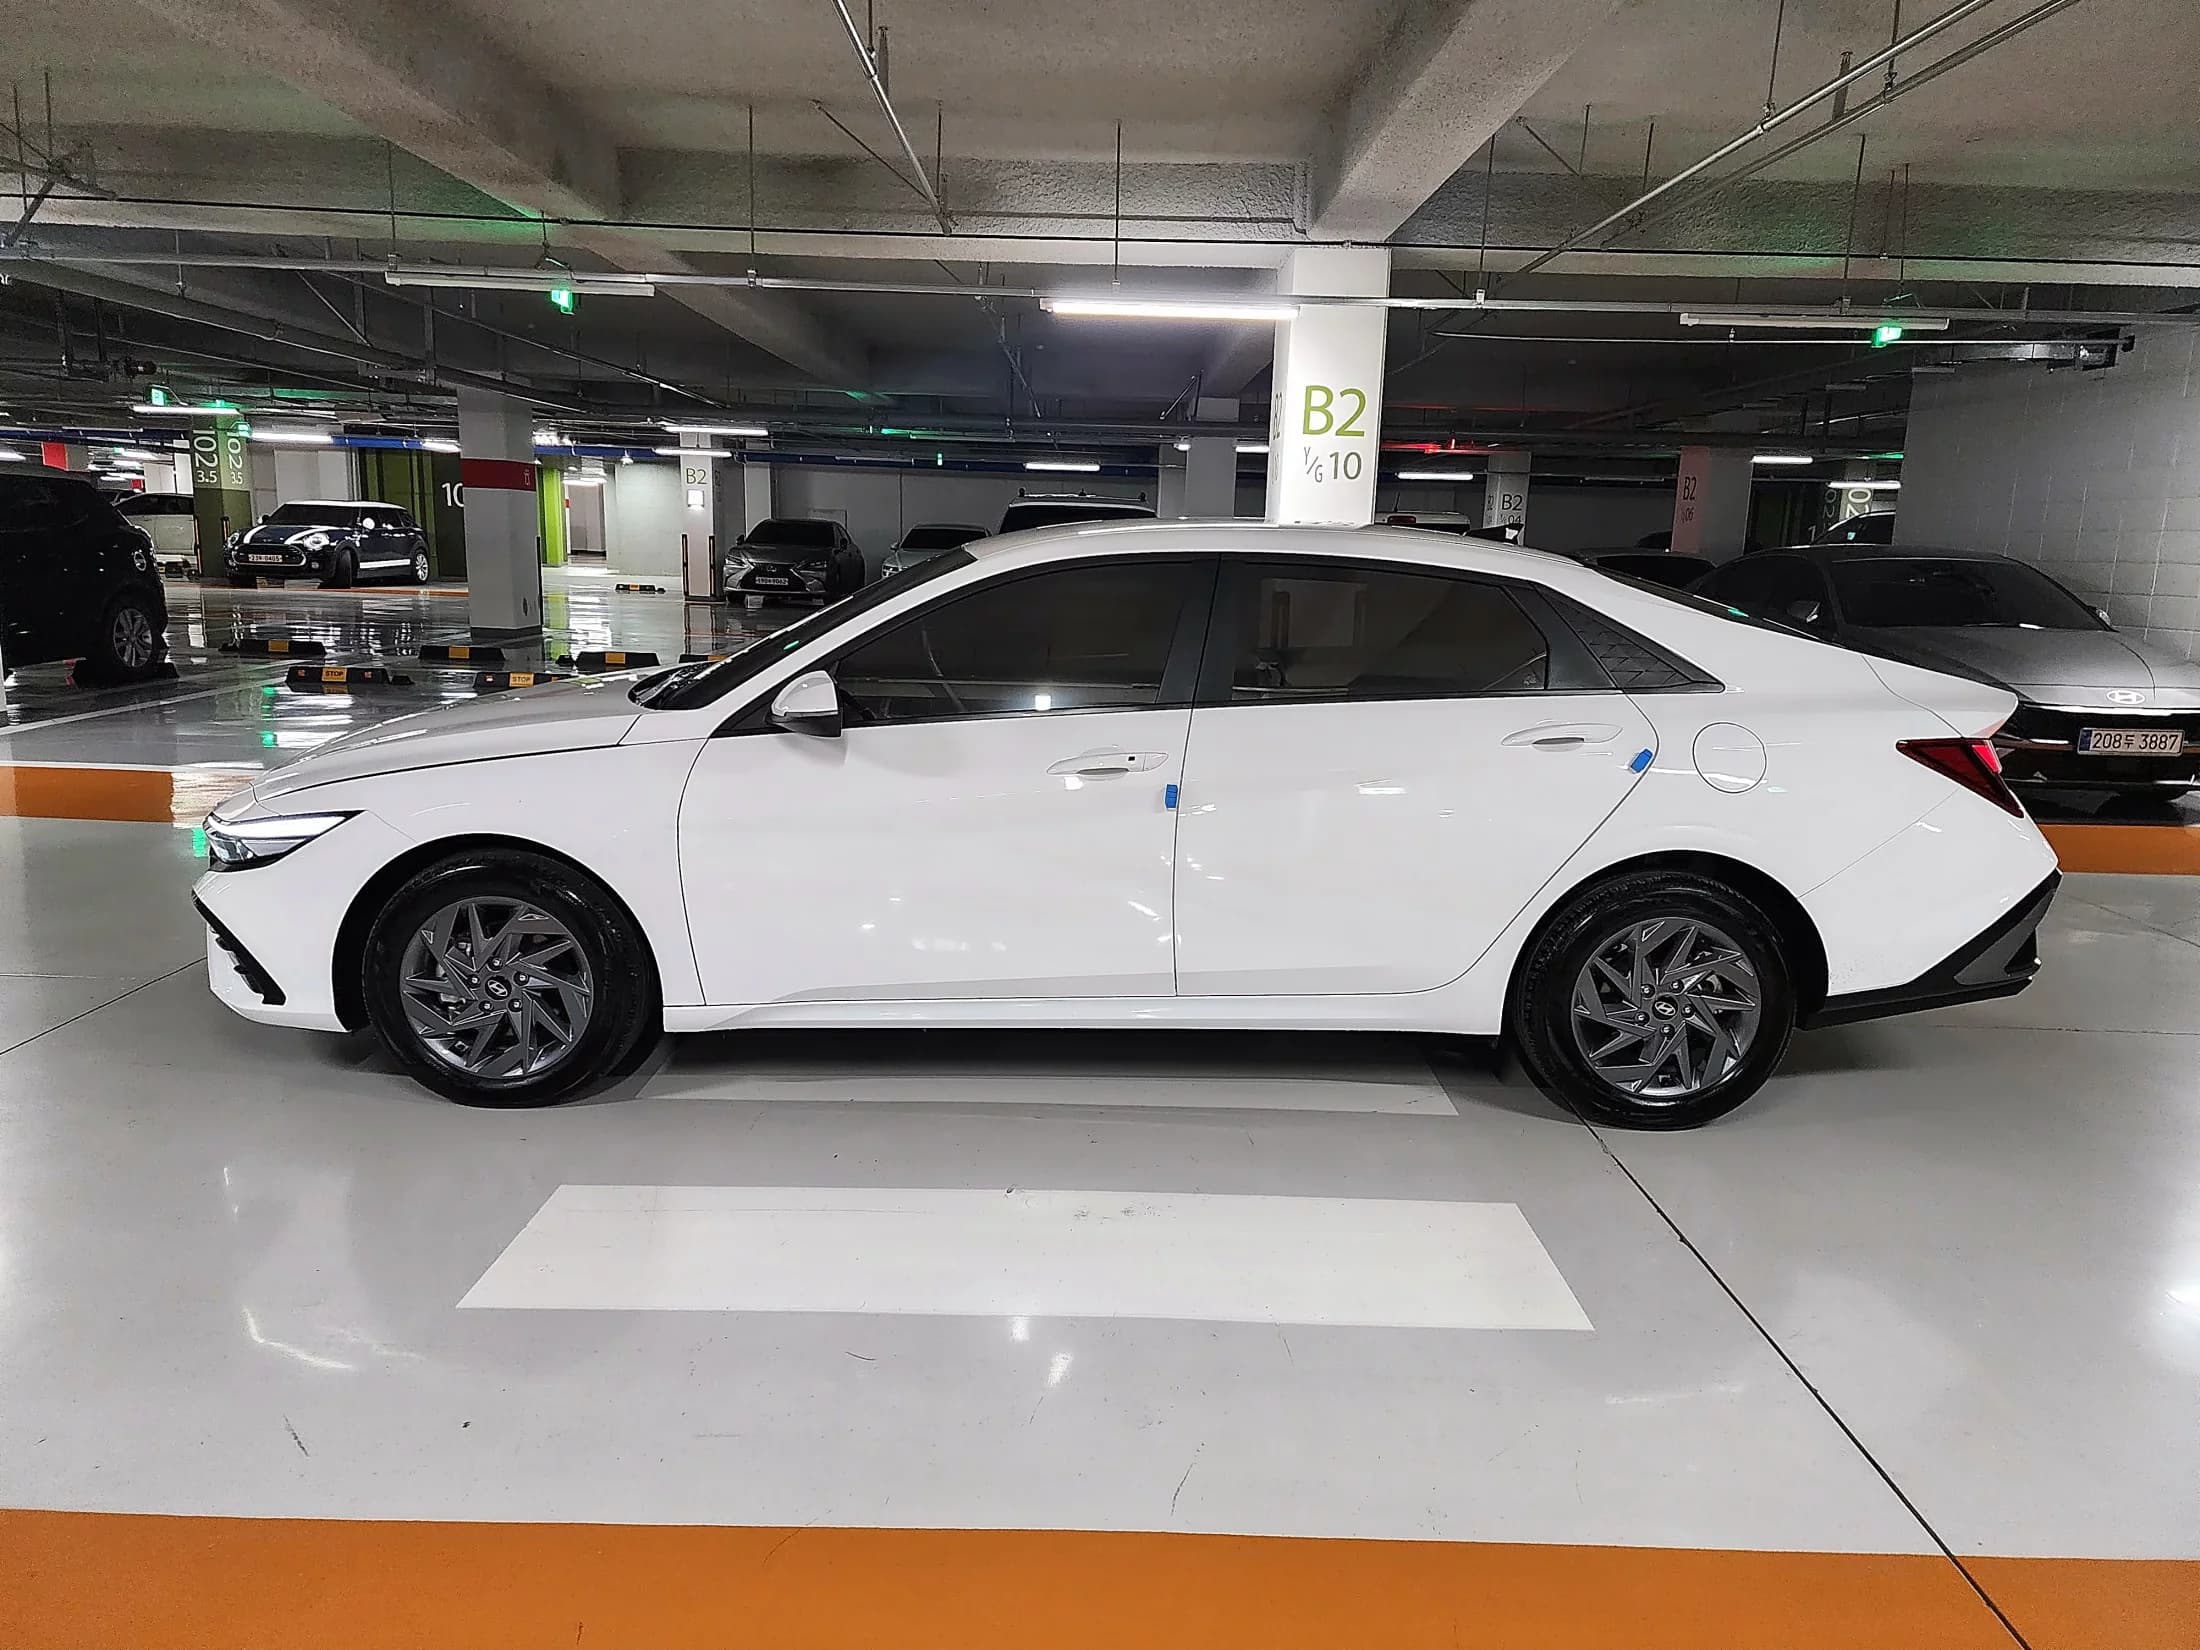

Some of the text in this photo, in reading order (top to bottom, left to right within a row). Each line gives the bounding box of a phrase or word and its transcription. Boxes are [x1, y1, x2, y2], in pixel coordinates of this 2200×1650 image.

[1303, 385, 1366, 437] B2
[192, 429, 218, 468] 102
[686, 467, 707, 485] B2
[1329, 451, 1362, 480] 10
[197, 470, 218, 483] 3.5
[1683, 476, 1697, 500] B2
[1502, 494, 1522, 510] B2
[2092, 733, 2179, 750] 208두 3887
